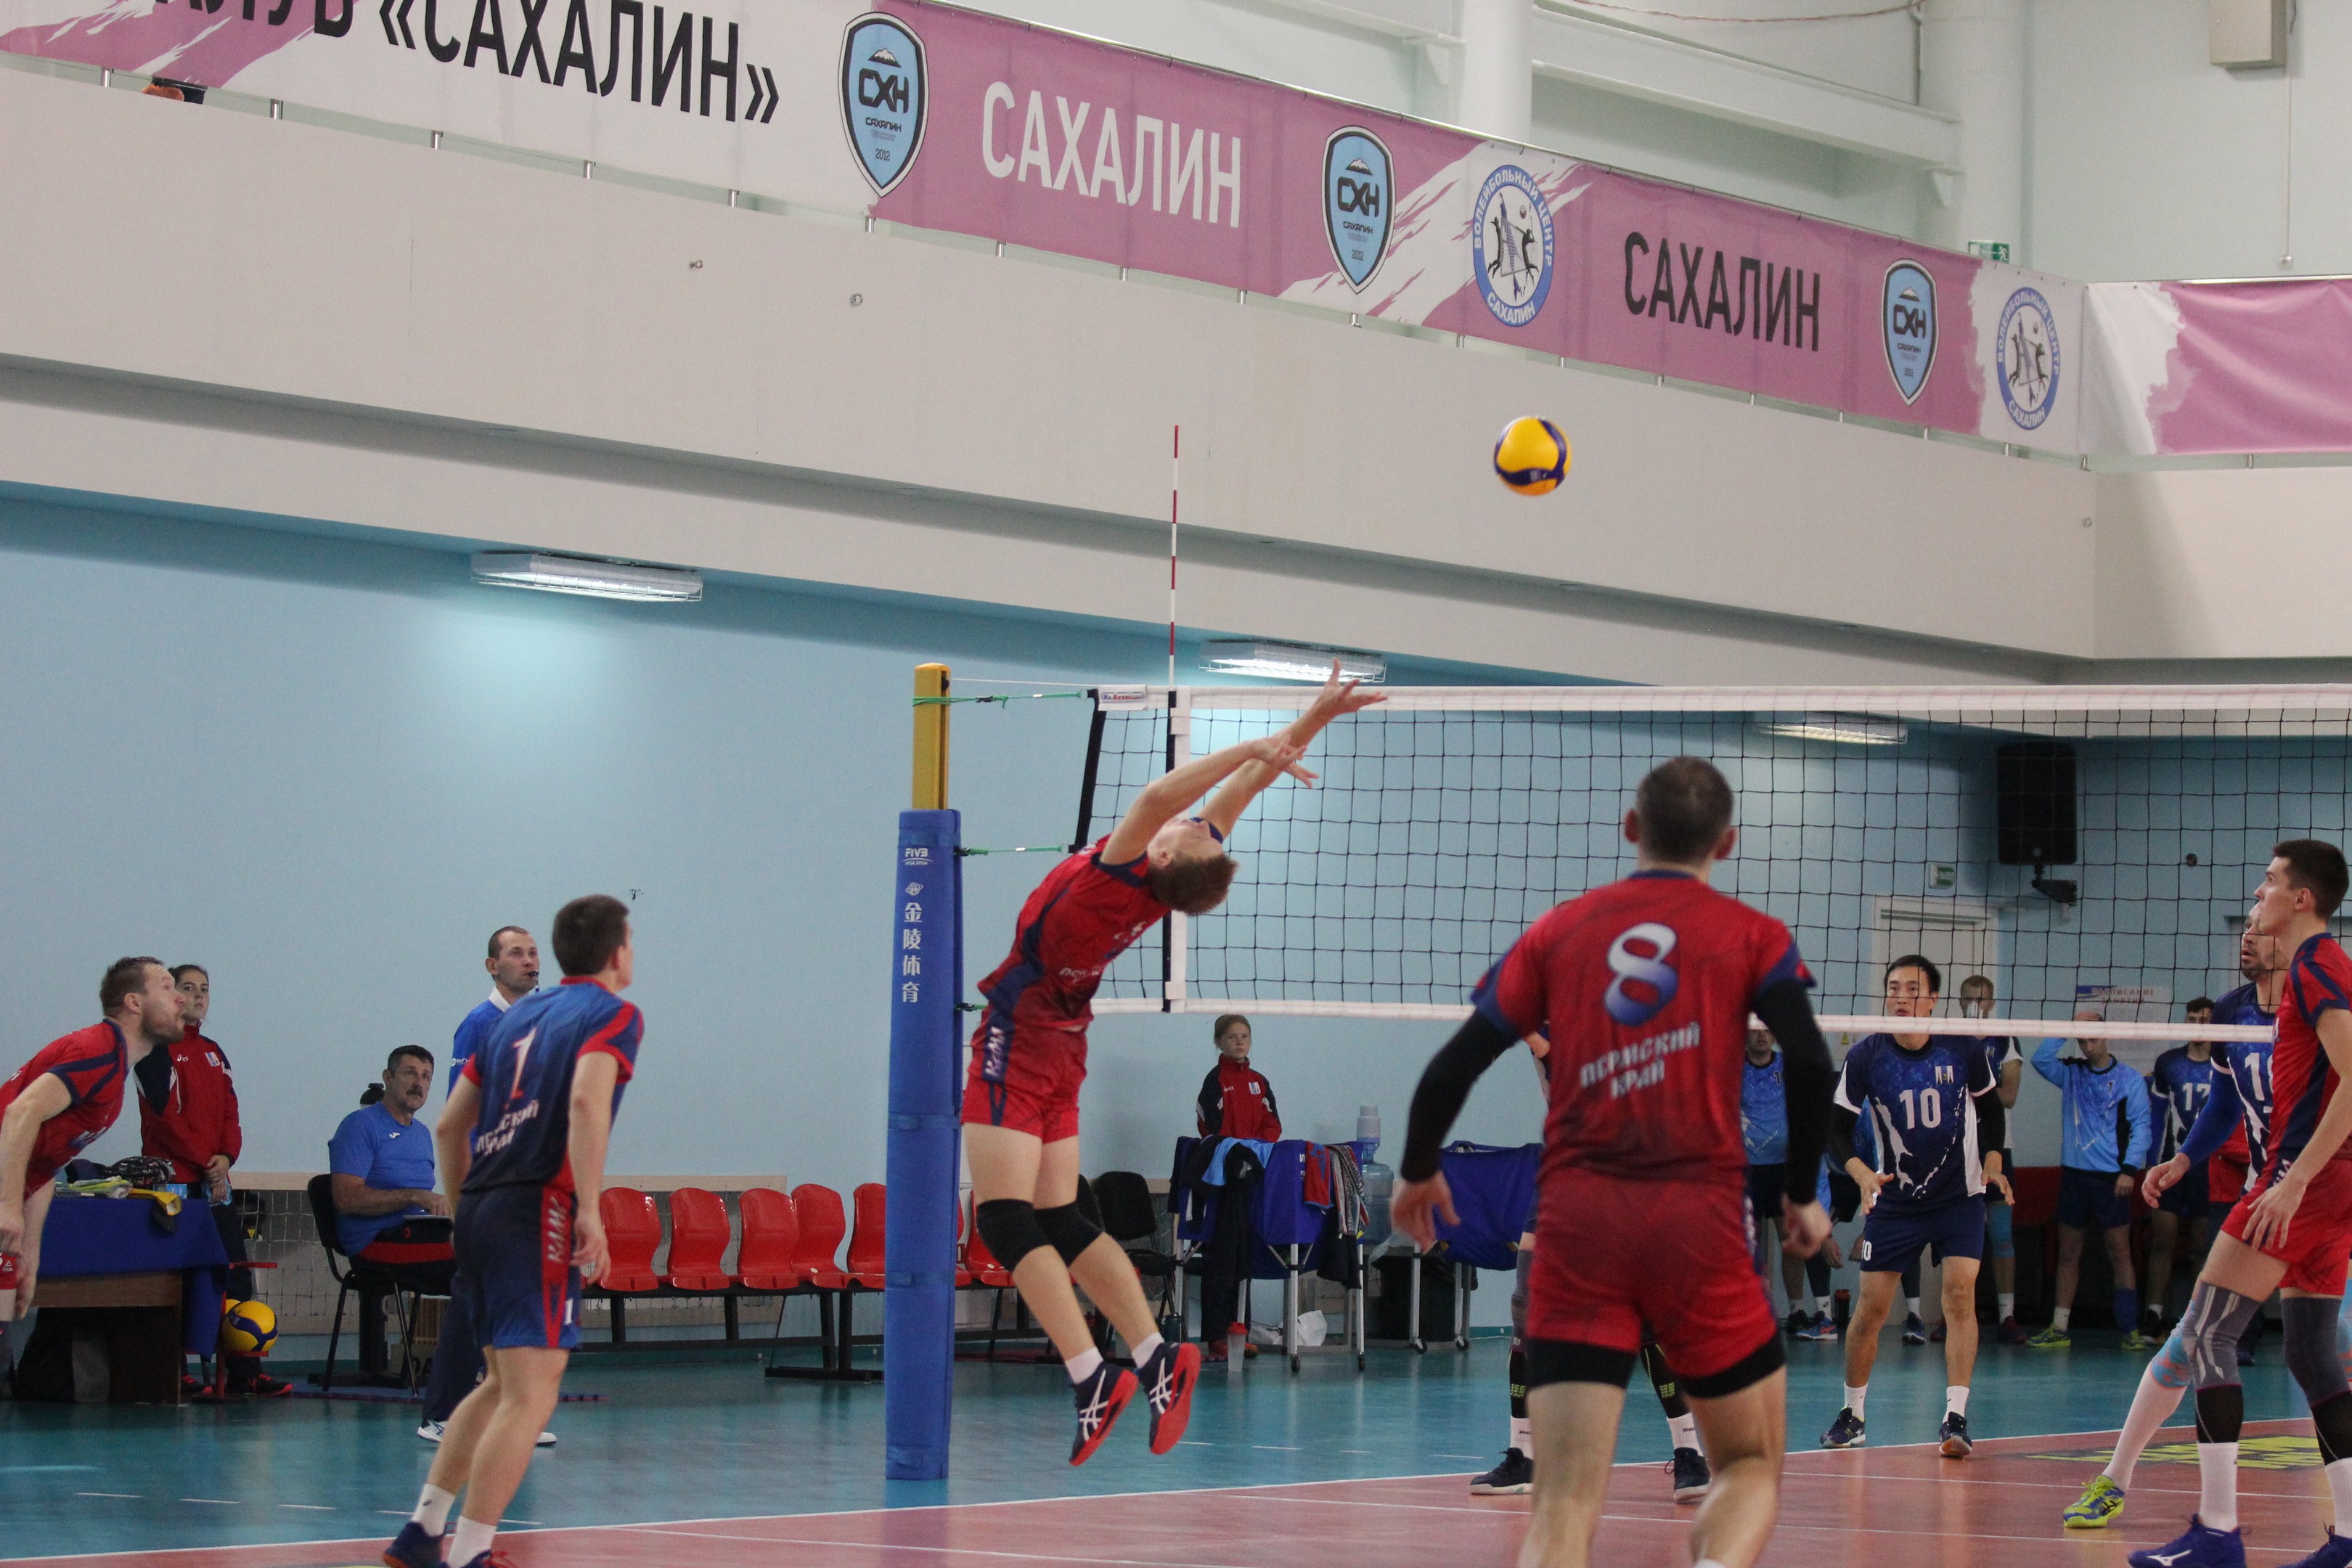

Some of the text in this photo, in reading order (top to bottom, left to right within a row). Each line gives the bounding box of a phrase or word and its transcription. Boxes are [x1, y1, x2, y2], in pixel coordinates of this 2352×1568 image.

[865, 116, 902, 132] САХАЛИН
[875, 148, 891, 161] 2012
[981, 81, 1241, 228] САХАЛИН
[1344, 221, 1373, 234] САХАЛИН
[1474, 169, 1553, 266] ВОЛЕЙБОЛЬНЫЙ ЦЕНТР
[1352, 249, 1364, 261] 2012
[1487, 291, 1536, 324] САХАЛИН
[1625, 231, 1821, 352] САХАЛИН
[905, 847, 928, 857] FIVB
[901, 902, 923, 1003] 金陵体育
[1604, 921, 1679, 1027] 8
[512, 1026, 537, 1099] 1
[2245, 1052, 2274, 1101] 1
[1899, 1087, 1942, 1130] 10
[2182, 1082, 2211, 1111] 17
[564, 1298, 573, 1326] 1
